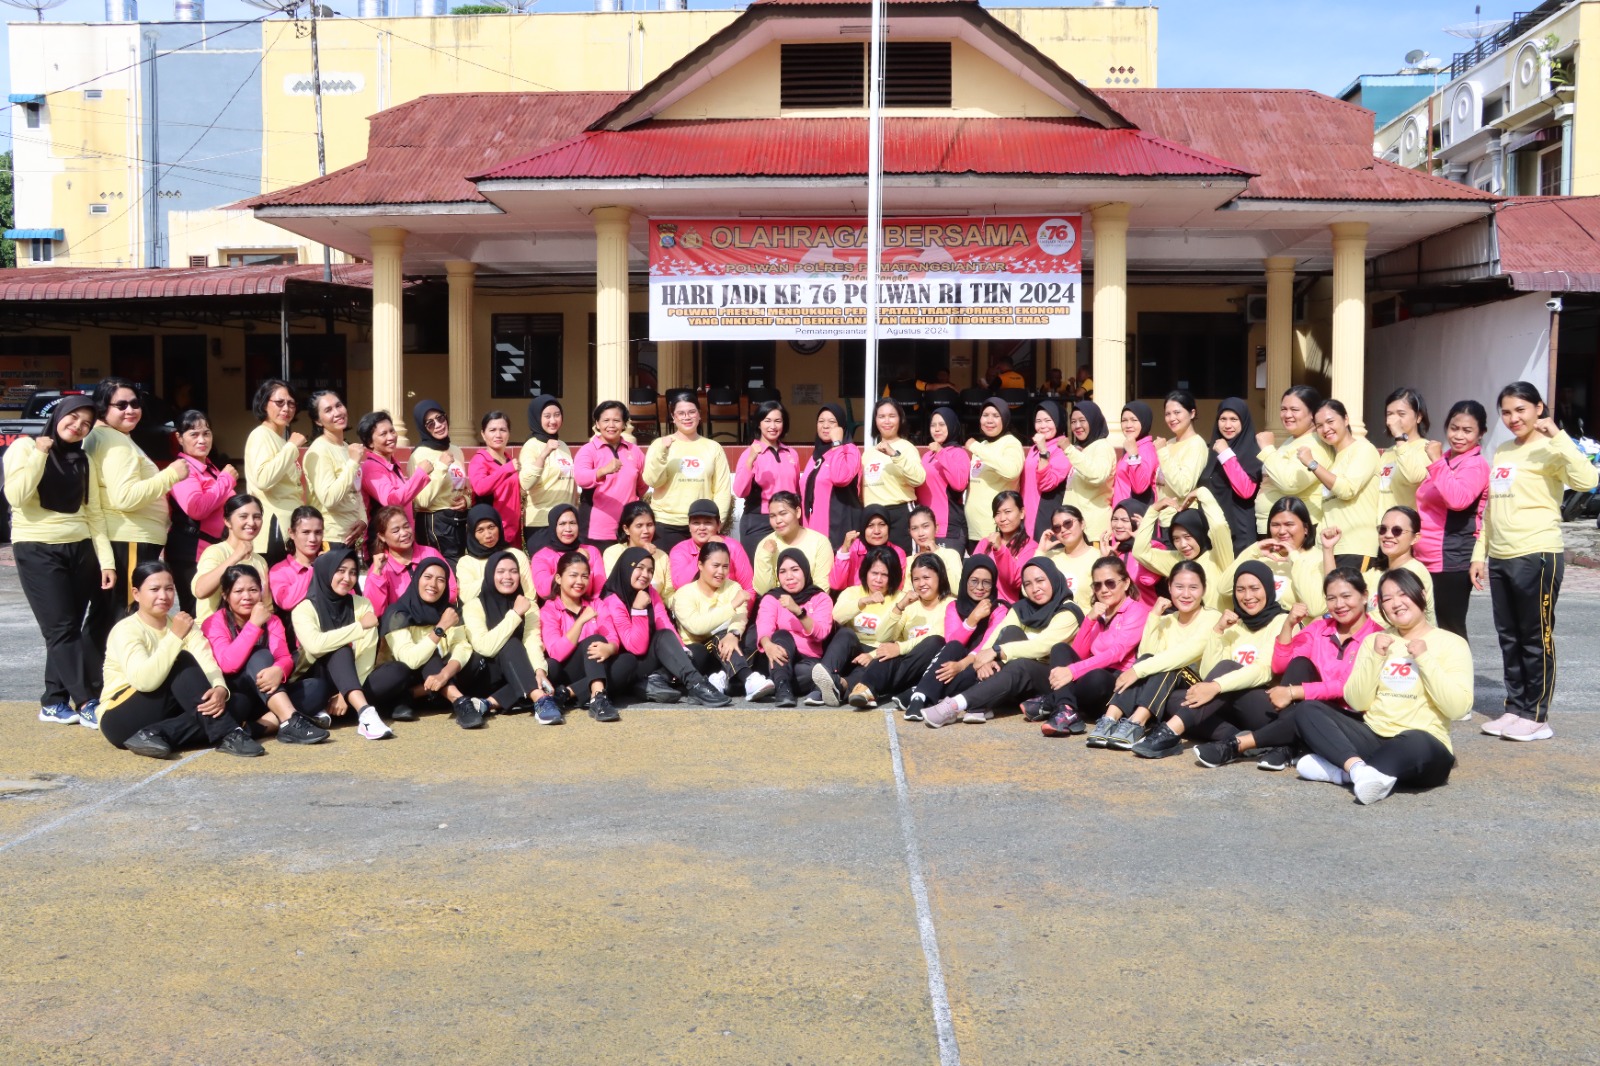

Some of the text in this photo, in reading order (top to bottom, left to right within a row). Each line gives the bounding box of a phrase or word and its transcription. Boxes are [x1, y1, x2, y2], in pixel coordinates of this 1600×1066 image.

[884, 223, 1030, 248] BERSAMA
[1045, 224, 1068, 240] 76
[726, 261, 1007, 273] POLWAN POLRES PMATANGSIANTAR
[661, 284, 714, 305] HARI
[720, 284, 767, 307] JADI
[775, 284, 801, 305] KE
[808, 283, 836, 305] 76
[938, 282, 962, 304] RI
[970, 282, 1012, 304] THN
[1019, 282, 1075, 304] 2024
[667, 306, 1070, 317] POLWAN PRESISI MENDUKUNG PEREPATAN TRANSFORMASI EKONOMI
[688, 316, 1049, 326] YANG INKLUSIF DAN BERKELANJTAN MENUJU INDONESIA EMAS
[886, 327, 921, 336] Agustus
[925, 327, 949, 335] 2024
[684, 458, 700, 468] 76
[869, 463, 881, 472] 76
[451, 468, 463, 478] 76
[1495, 467, 1512, 479] 76
[861, 615, 877, 629] 76
[1238, 650, 1255, 665] 76
[1390, 662, 1412, 676] 76
